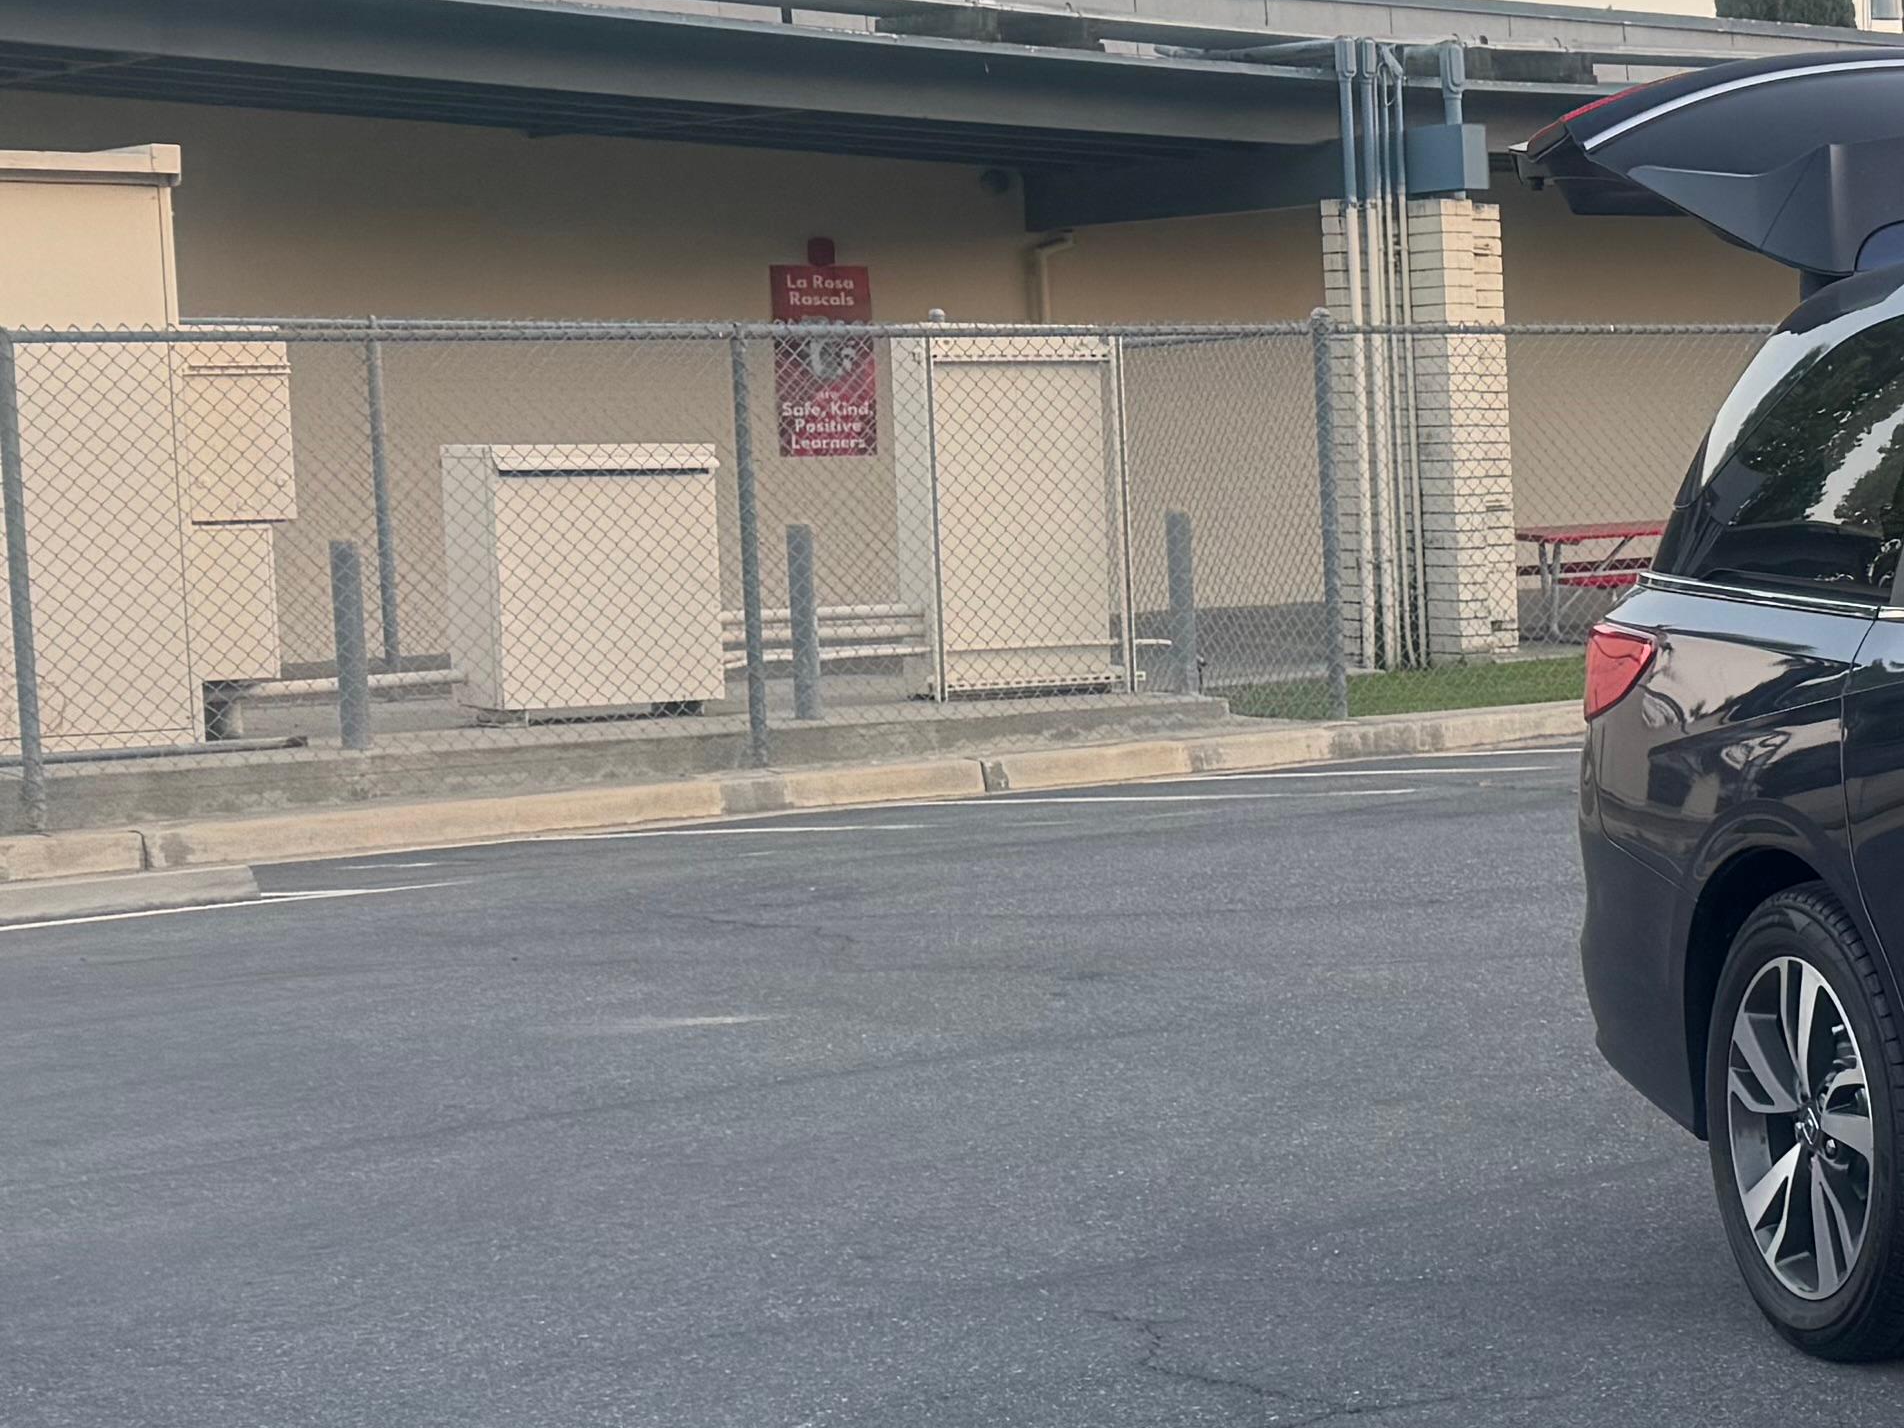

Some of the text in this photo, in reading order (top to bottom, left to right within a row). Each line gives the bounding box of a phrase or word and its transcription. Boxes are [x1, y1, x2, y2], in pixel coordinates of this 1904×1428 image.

[786, 274, 854, 289] La Rosa
[789, 291, 855, 306] Rascals
[782, 401, 826, 418] Safe,
[795, 418, 862, 433] Positive
[792, 434, 866, 449] Learners
